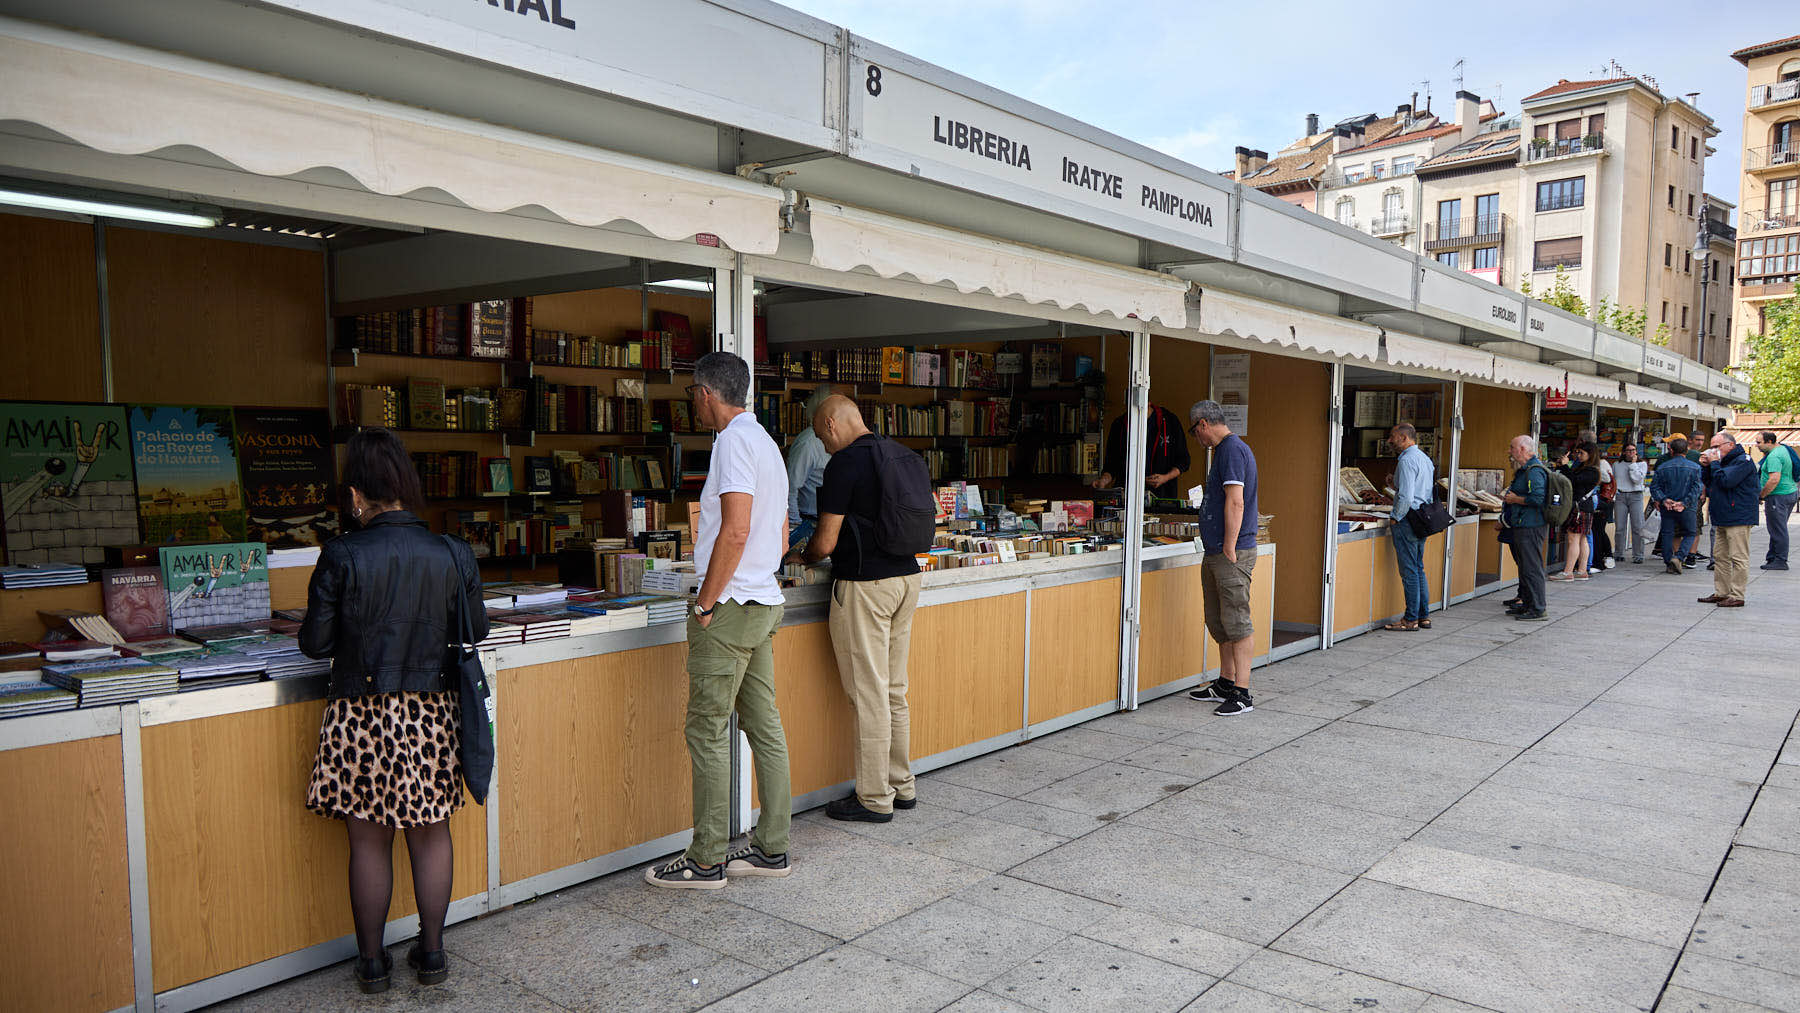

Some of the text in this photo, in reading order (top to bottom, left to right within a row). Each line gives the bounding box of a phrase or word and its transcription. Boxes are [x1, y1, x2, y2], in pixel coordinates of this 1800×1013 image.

[486, 0, 576, 31] AL
[866, 65, 882, 97] 8
[933, 115, 1213, 227] LIBRERIA IRATXE PAMPLONA
[1421, 268, 1426, 283] 7
[136, 430, 216, 442] Palacio de
[237, 432, 321, 449] VASCONIA
[142, 442, 213, 456] los Reyes
[137, 453, 220, 465] de Navarra
[112, 575, 158, 585] NAVARRA
